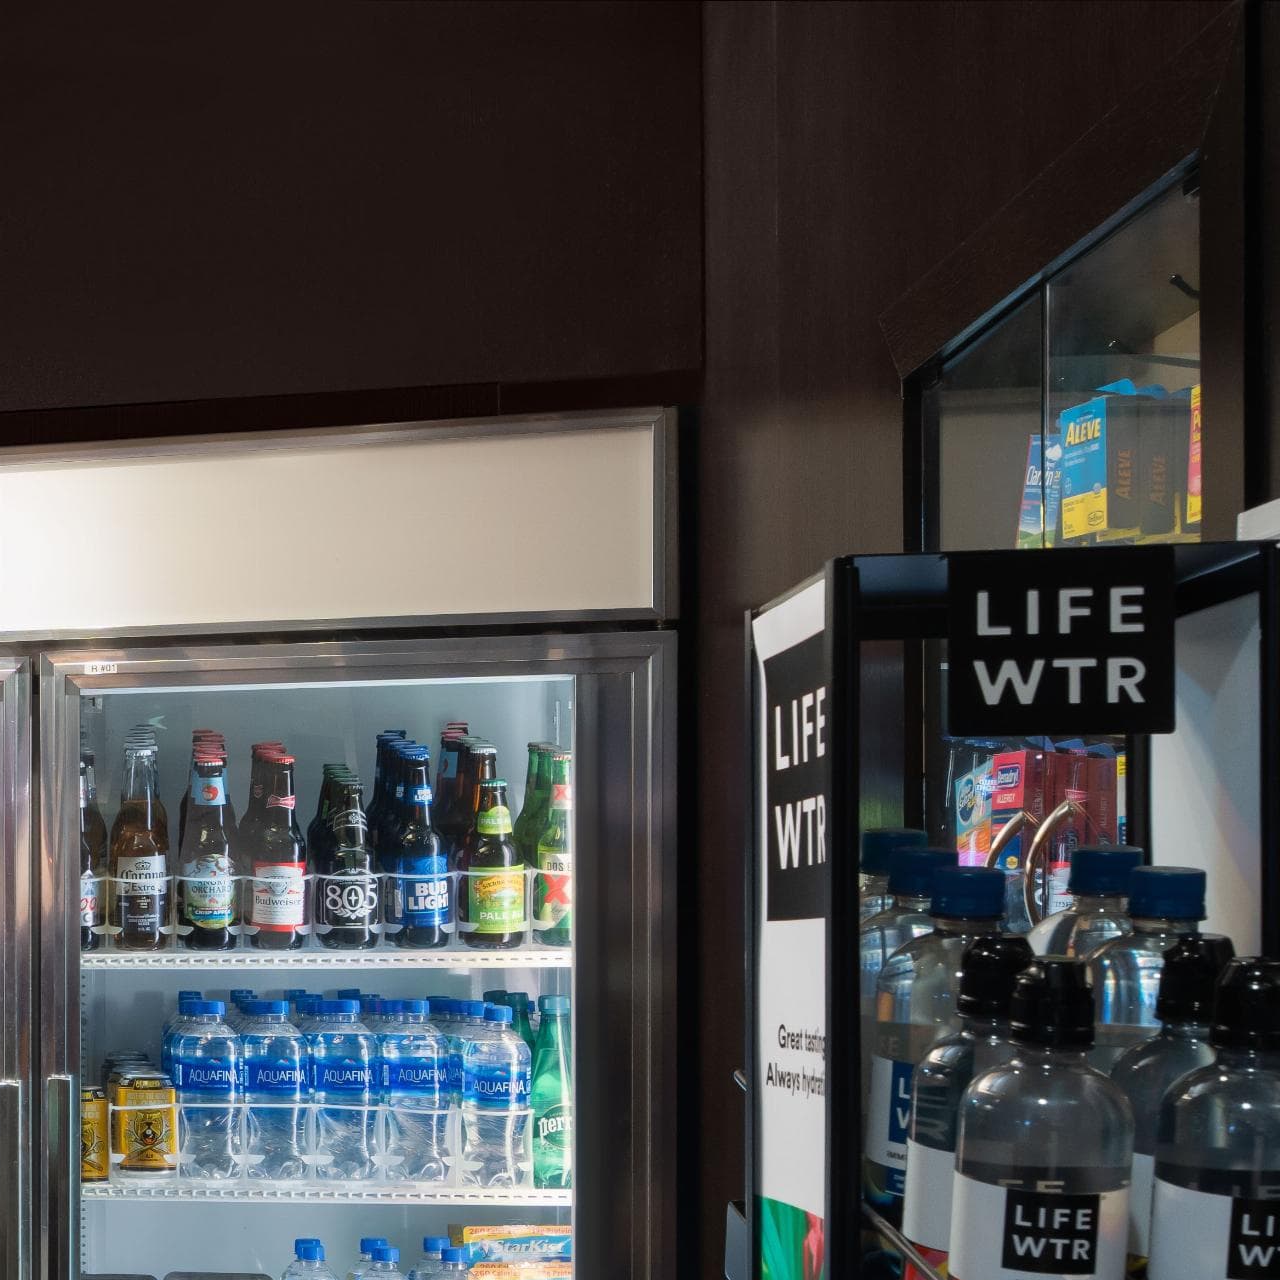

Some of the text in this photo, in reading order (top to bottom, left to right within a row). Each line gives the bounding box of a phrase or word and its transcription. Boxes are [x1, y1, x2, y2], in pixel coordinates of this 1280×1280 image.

[1065, 417, 1101, 447] ALEVE
[976, 585, 1146, 637] LIFE
[973, 656, 1147, 706] WTR
[774, 685, 826, 772] LIFE
[997, 767, 1019, 785] Benadryl
[774, 793, 826, 871] WTR
[546, 862, 564, 872] DOS
[191, 885, 233, 894] ORCHARD
[255, 895, 302, 906] Budweiser
[326, 881, 378, 911] 805
[415, 882, 448, 897] BUD
[777, 1024, 803, 1050] Great
[257, 1068, 306, 1085] AQUAFINA
[473, 1079, 527, 1095] AQUAFINA
[766, 1062, 801, 1097] Always
[1014, 1207, 1093, 1230] LIFE
[1013, 1235, 1091, 1261] WTR
